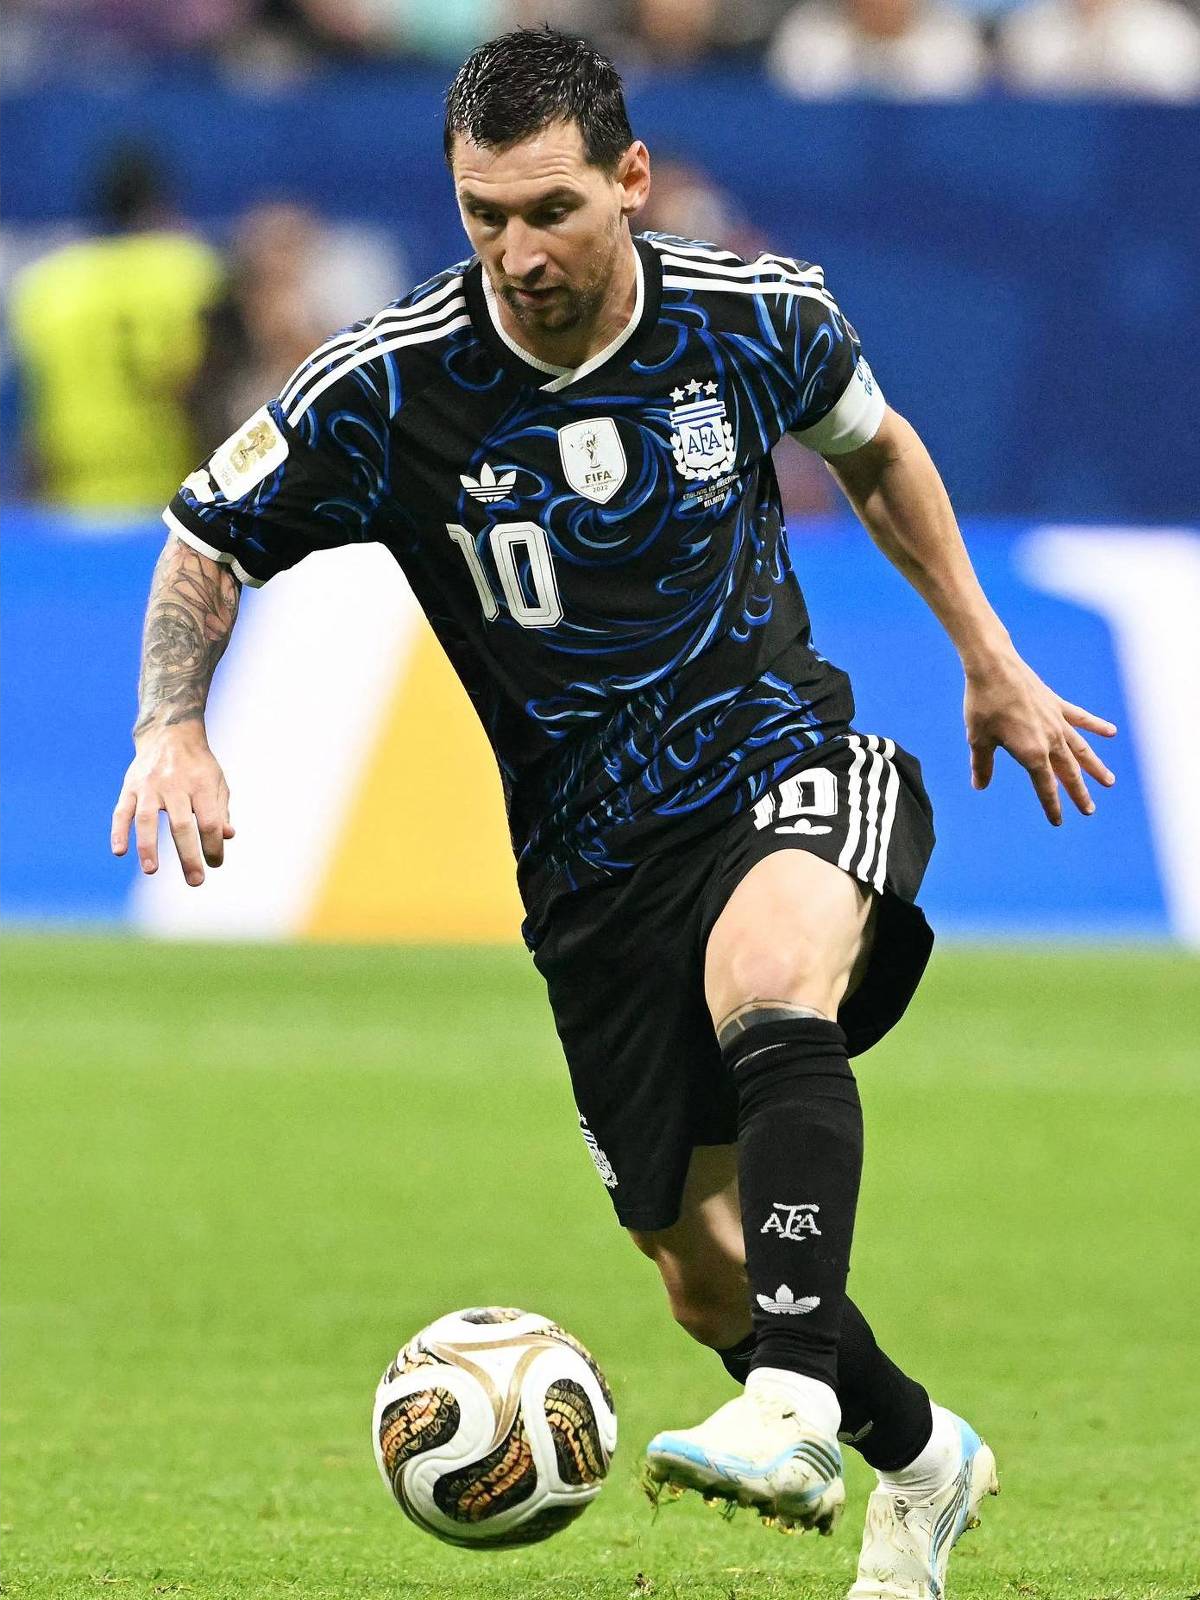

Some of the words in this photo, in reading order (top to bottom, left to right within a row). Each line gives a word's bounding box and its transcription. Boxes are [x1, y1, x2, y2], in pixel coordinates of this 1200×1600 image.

[687, 422, 722, 456] AFA
[585, 470, 612, 484] FIFA
[445, 521, 564, 629] 10
[760, 1202, 822, 1240] AFA
